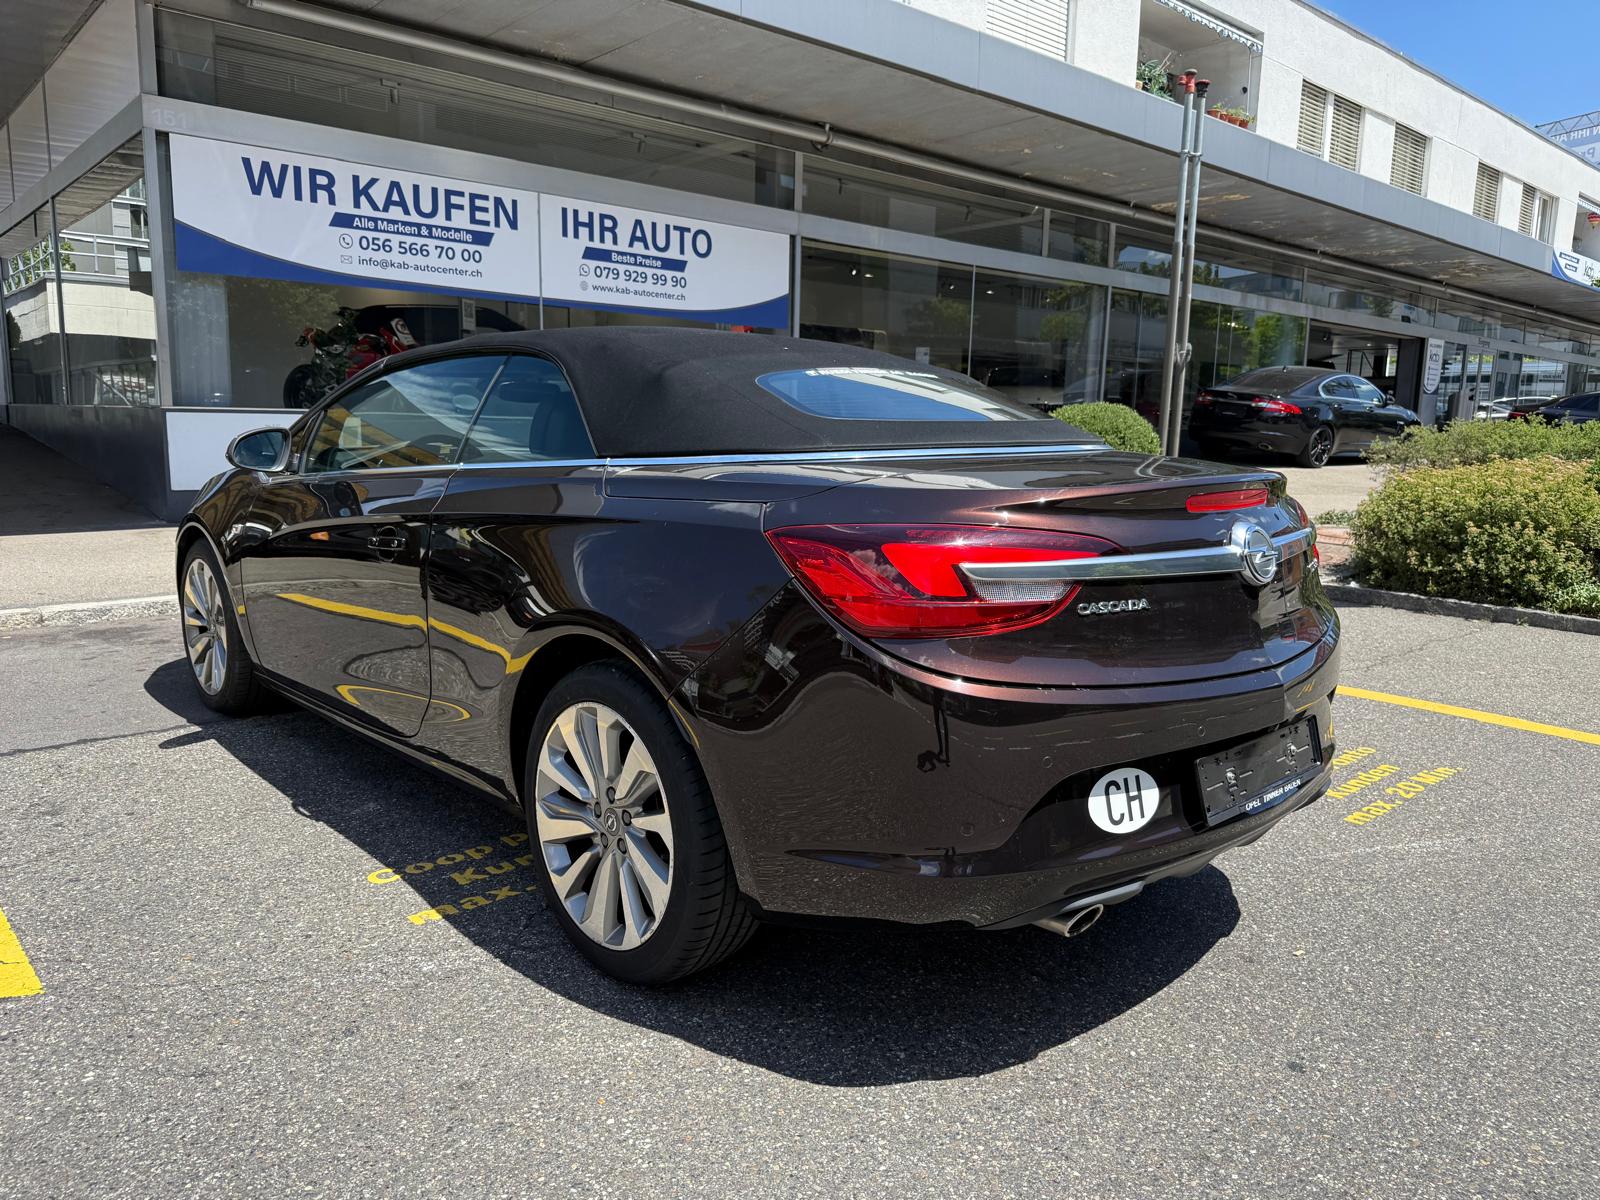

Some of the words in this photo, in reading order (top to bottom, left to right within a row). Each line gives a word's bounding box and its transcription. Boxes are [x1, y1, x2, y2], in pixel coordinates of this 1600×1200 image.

[241, 156, 336, 206] WIR
[352, 174, 519, 231] KAUFEN
[353, 217, 375, 229] Alle
[377, 219, 418, 235] Marken
[420, 227, 429, 236] &
[432, 228, 473, 242] Modelle
[561, 207, 618, 246] IHR
[628, 219, 713, 258] AUTO
[359, 236, 393, 253] 056
[397, 241, 430, 257] 566
[435, 245, 456, 260] 70
[461, 249, 483, 264] 00
[611, 253, 635, 264] Beste
[636, 255, 662, 268] Preise
[358, 256, 483, 278] info@kab-autocenter.ch
[594, 265, 620, 280] 079
[624, 268, 648, 283] 929
[651, 273, 667, 286] 99
[671, 276, 687, 289] 90
[592, 283, 686, 301] www.kab-autocenter.ch
[1077, 598, 1151, 615] CASCADA
[1333, 747, 1377, 768] onto
[1245, 799, 1262, 811] OPEL
[1284, 779, 1301, 792] BADEN
[1325, 764, 1400, 799] Kunden
[1104, 774, 1145, 826] CH
[1343, 800, 1403, 826] max.
[1384, 781, 1425, 799] 20
[1409, 767, 1463, 785] Min.
[367, 845, 494, 885] Coop
